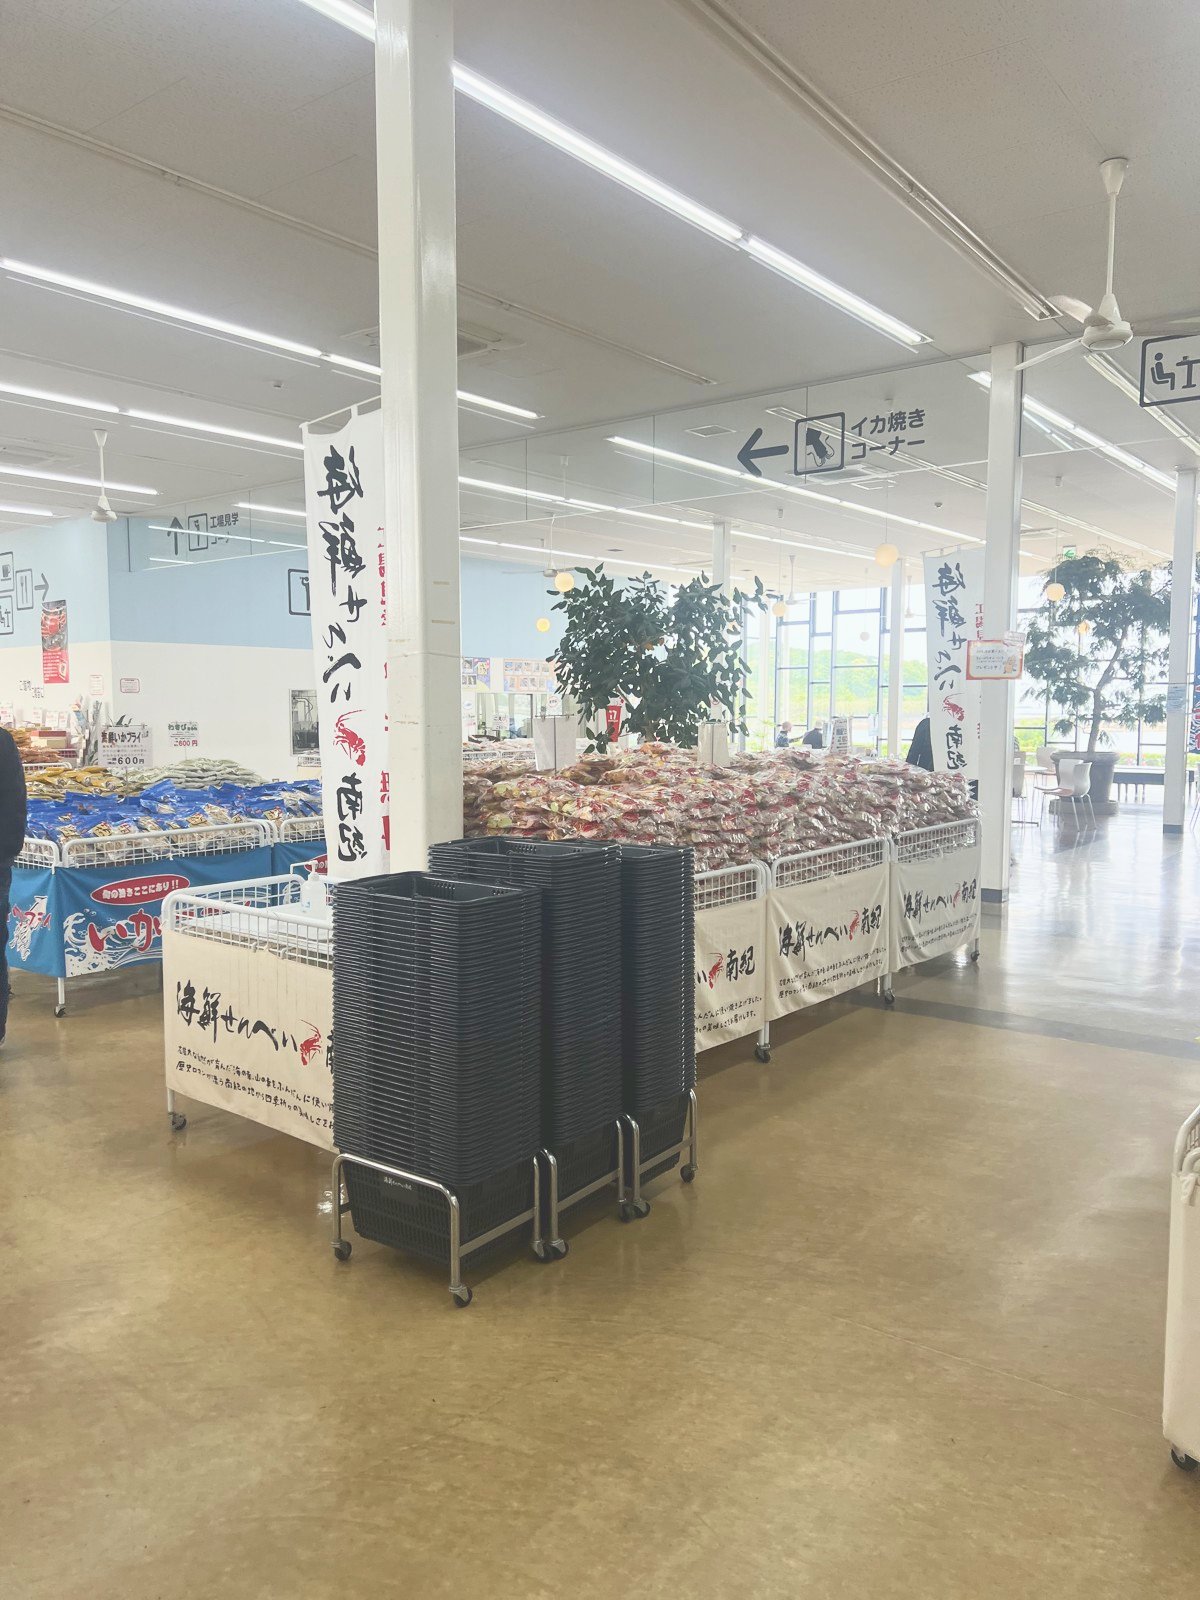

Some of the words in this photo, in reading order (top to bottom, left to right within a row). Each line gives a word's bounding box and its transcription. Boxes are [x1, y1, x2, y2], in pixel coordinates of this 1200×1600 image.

[851, 409, 925, 437] イカ焼き
[851, 436, 925, 460] コーナー
[210, 512, 238, 528] 工場見学
[778, 920, 848, 962] 海鮮せんべい
[861, 904, 882, 936] 南紀
[726, 945, 756, 983] 南紀
[176, 979, 299, 1053] 海鮮せんべい
